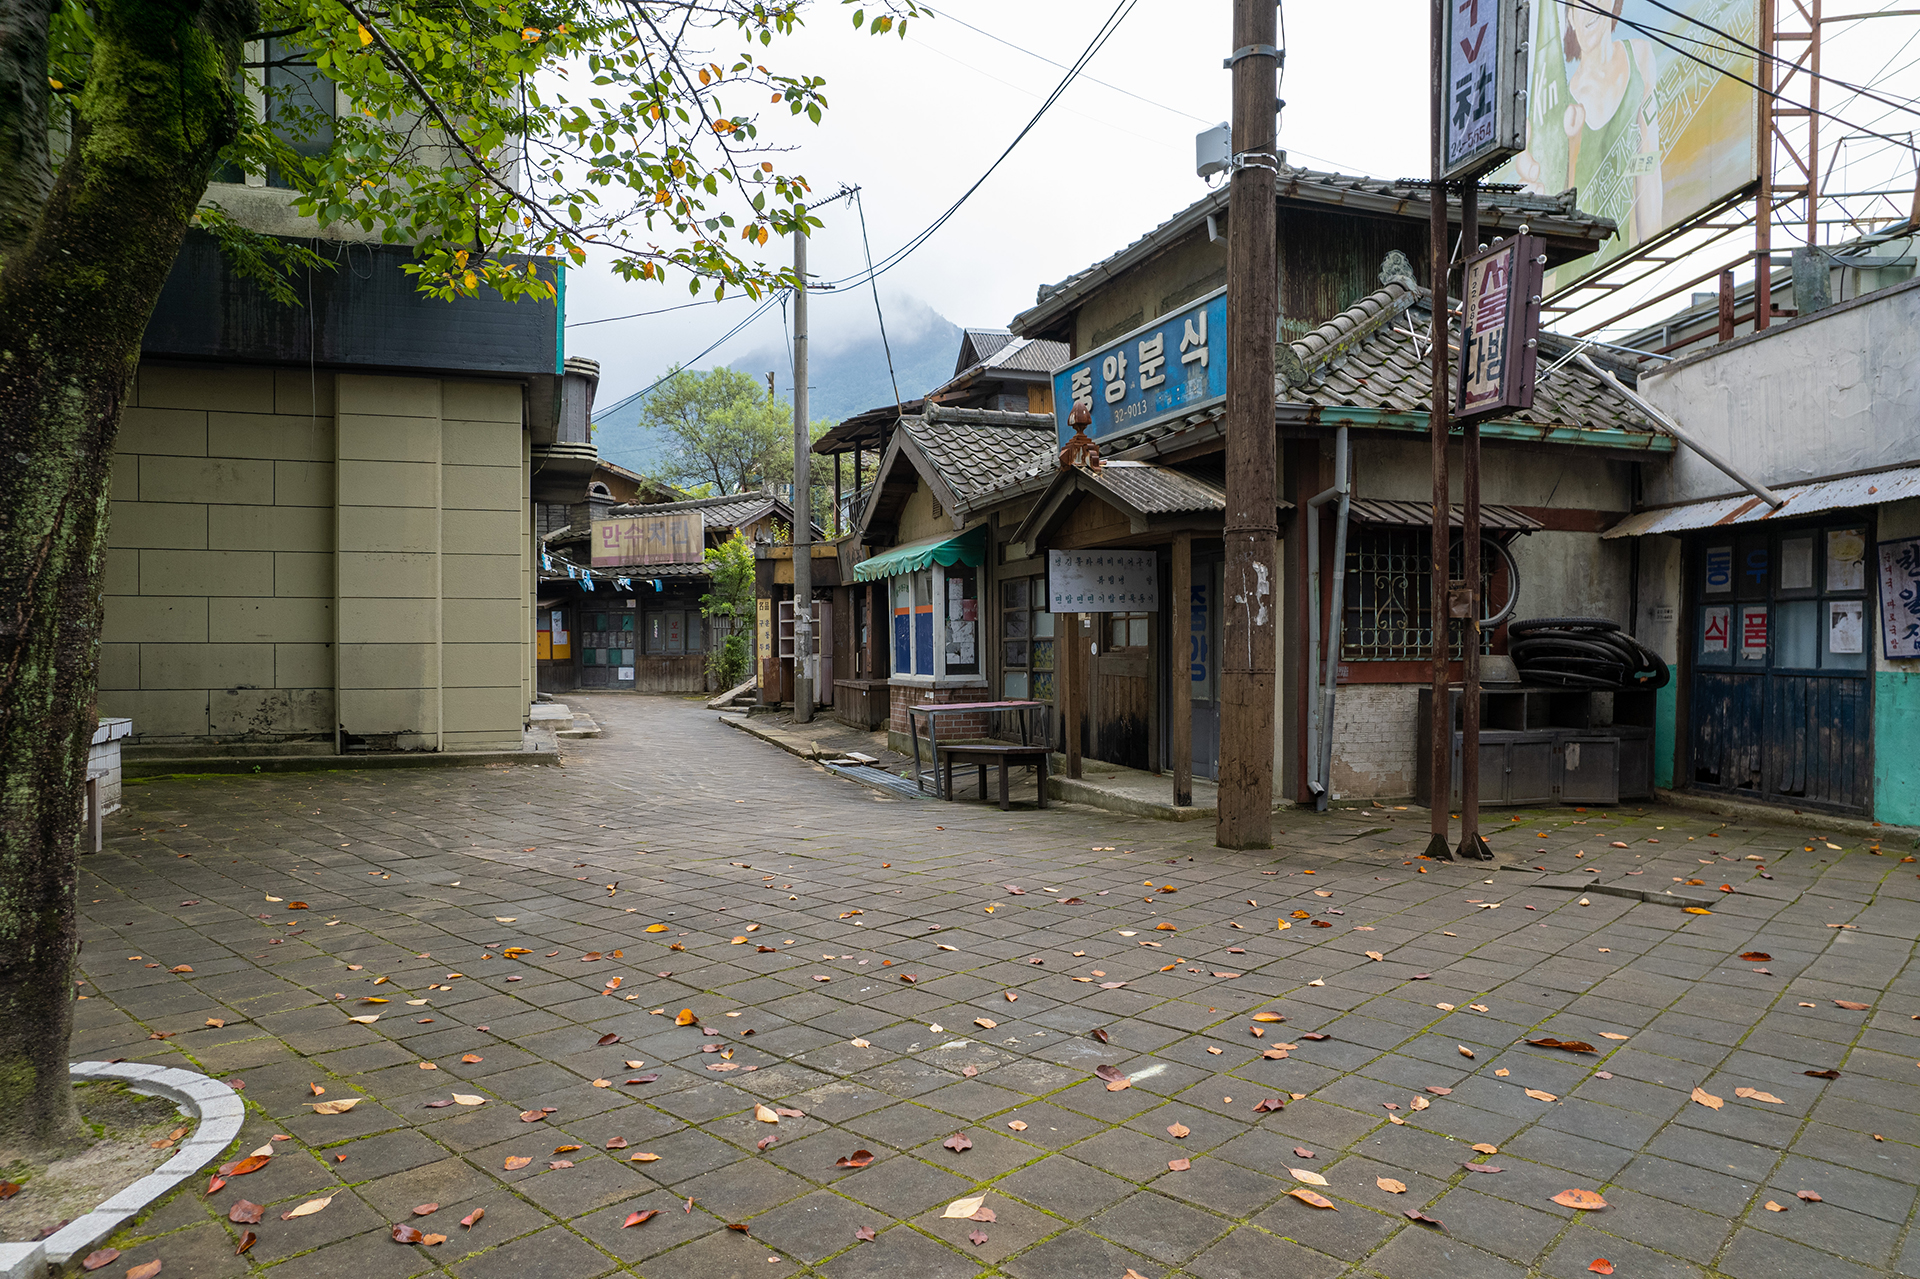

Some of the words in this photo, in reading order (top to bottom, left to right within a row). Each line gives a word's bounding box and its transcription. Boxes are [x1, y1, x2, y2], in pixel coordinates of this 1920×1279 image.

[1533, 61, 1559, 127] Kin
[1071, 310, 1209, 416] 중앙분식
[1114, 400, 1148, 424] 32-9013
[602, 519, 689, 549] 만수치킨
[1705, 613, 1767, 648] 식품
